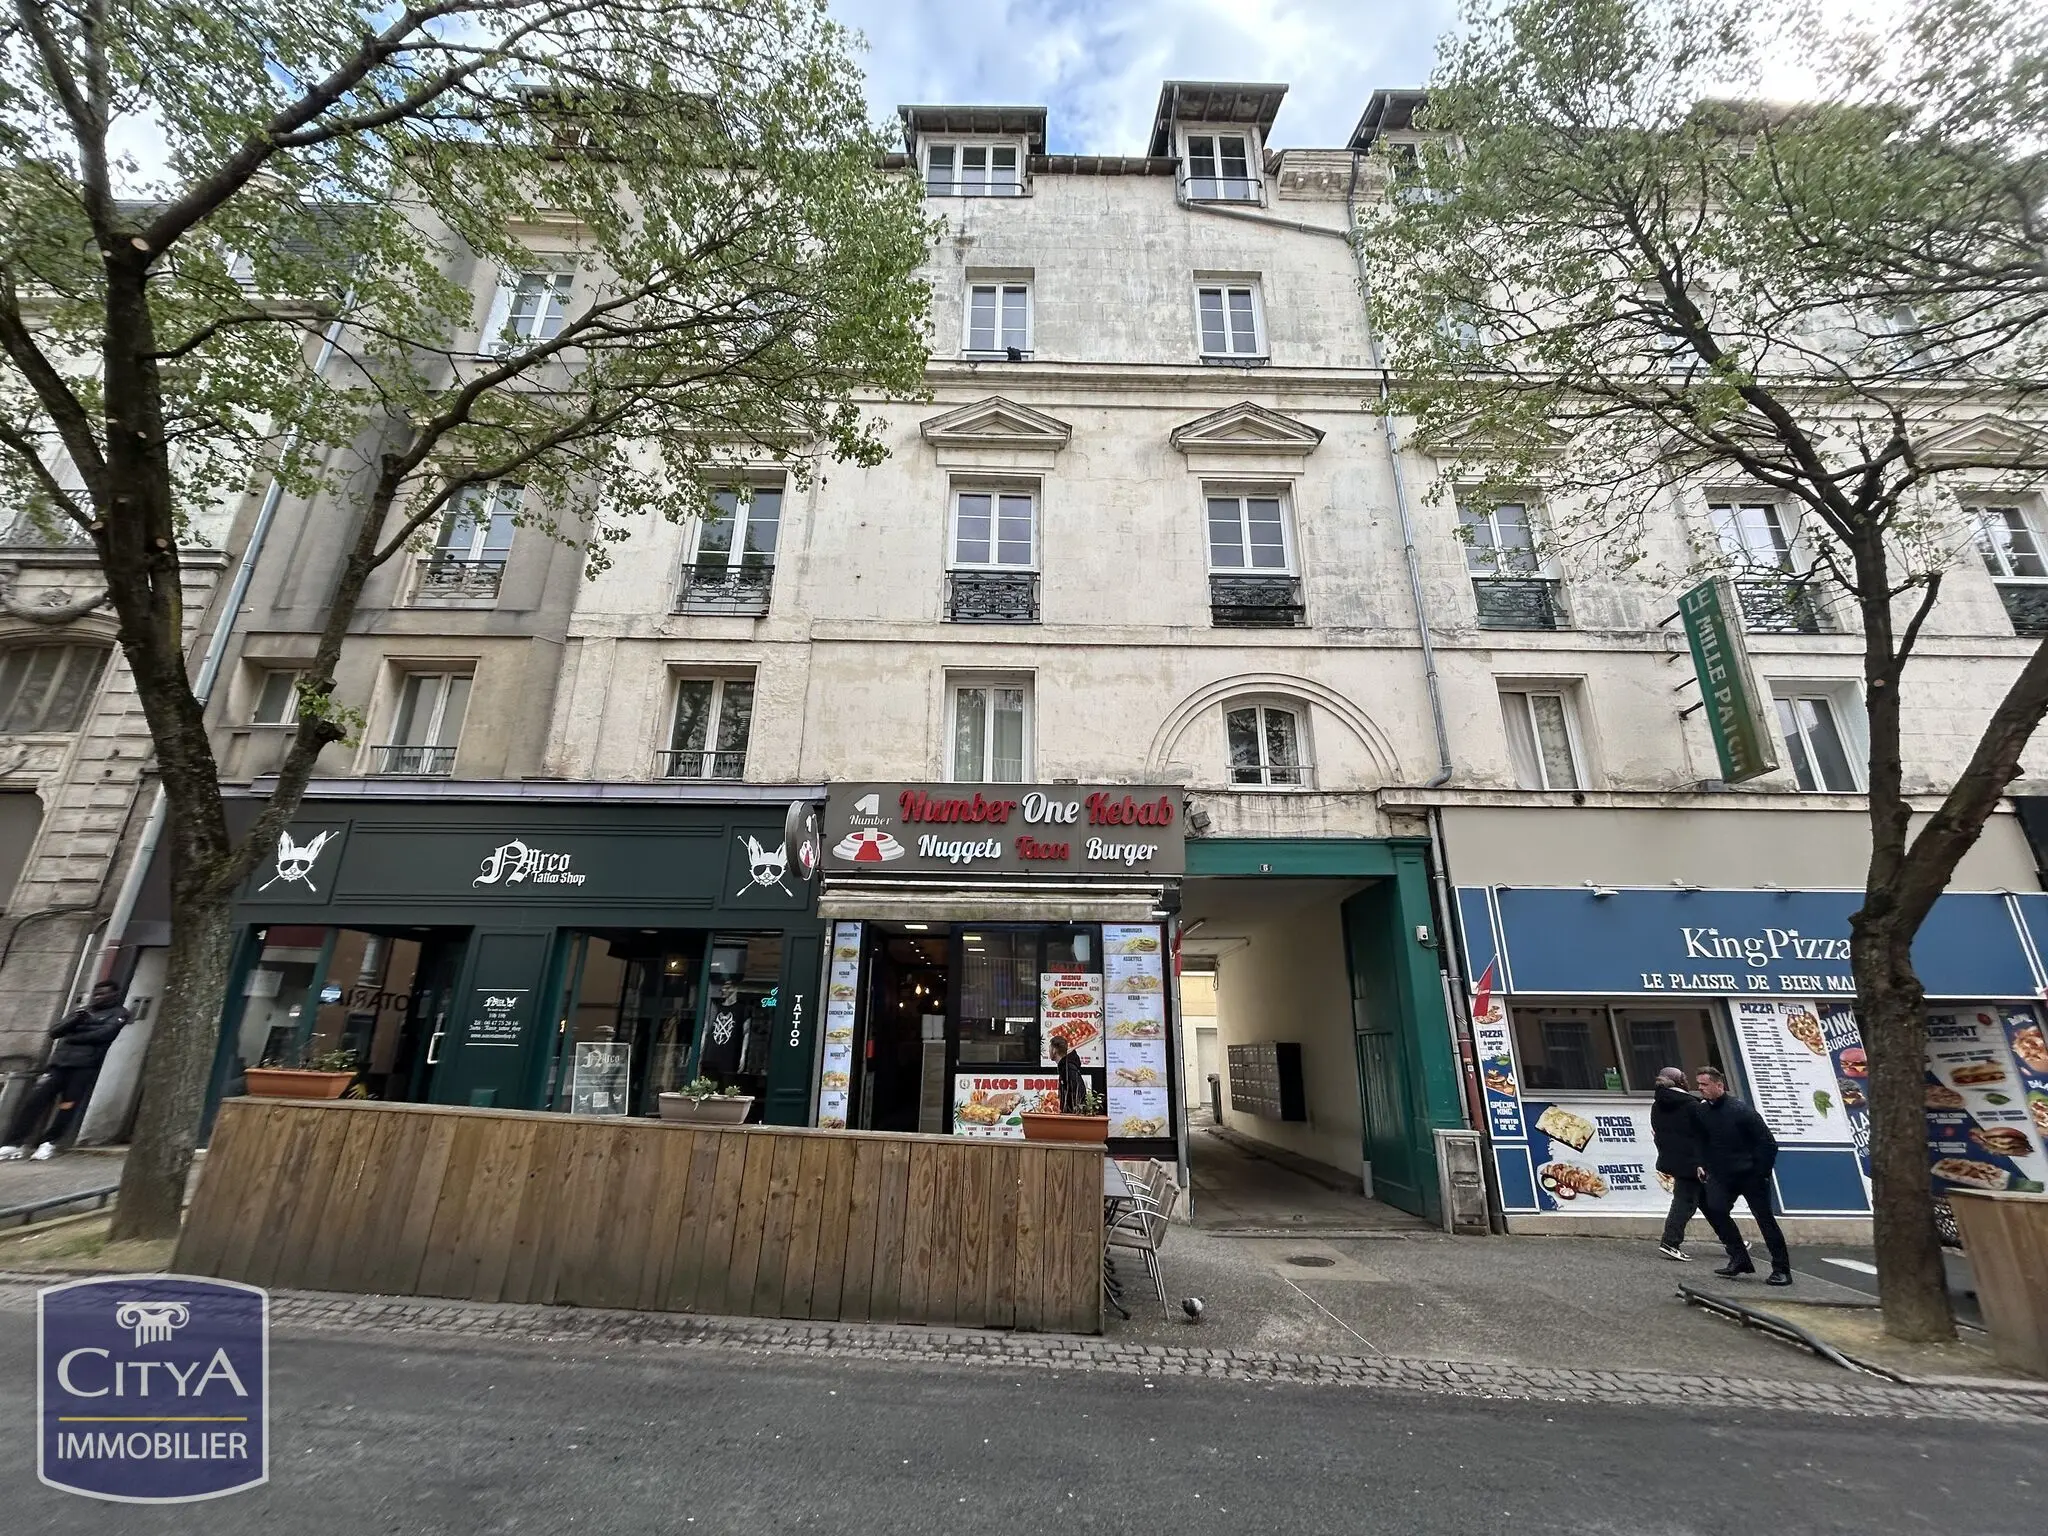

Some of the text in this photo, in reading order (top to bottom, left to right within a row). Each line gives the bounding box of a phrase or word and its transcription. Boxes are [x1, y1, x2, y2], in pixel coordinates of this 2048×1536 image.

[1686, 587, 1712, 615] LE
[1695, 614, 1727, 684] MILLE
[899, 790, 1175, 826] Number One Kebab
[849, 814, 893, 825] Number
[917, 834, 1158, 867] Nuggets Tacos Burger
[560, 872, 586, 887] Shop
[1641, 973, 1857, 991] LE PLAISIR DE BIEN MA
[1740, 1003, 1775, 1014] PIZZA
[789, 994, 803, 1047] TATTOO
[1819, 1011, 1858, 1038] PINK
[1479, 1030, 1503, 1038] PIZZA
[1826, 1031, 1862, 1053] BURGER
[973, 1079, 1018, 1090] TACOS
[1496, 1108, 1513, 1116] KING
[1595, 1116, 1632, 1127] TACOS
[1597, 1128, 1635, 1136] AU FOUR
[1598, 1164, 1645, 1174] BAGUETTE
[1610, 1174, 1642, 1184] FARCIE
